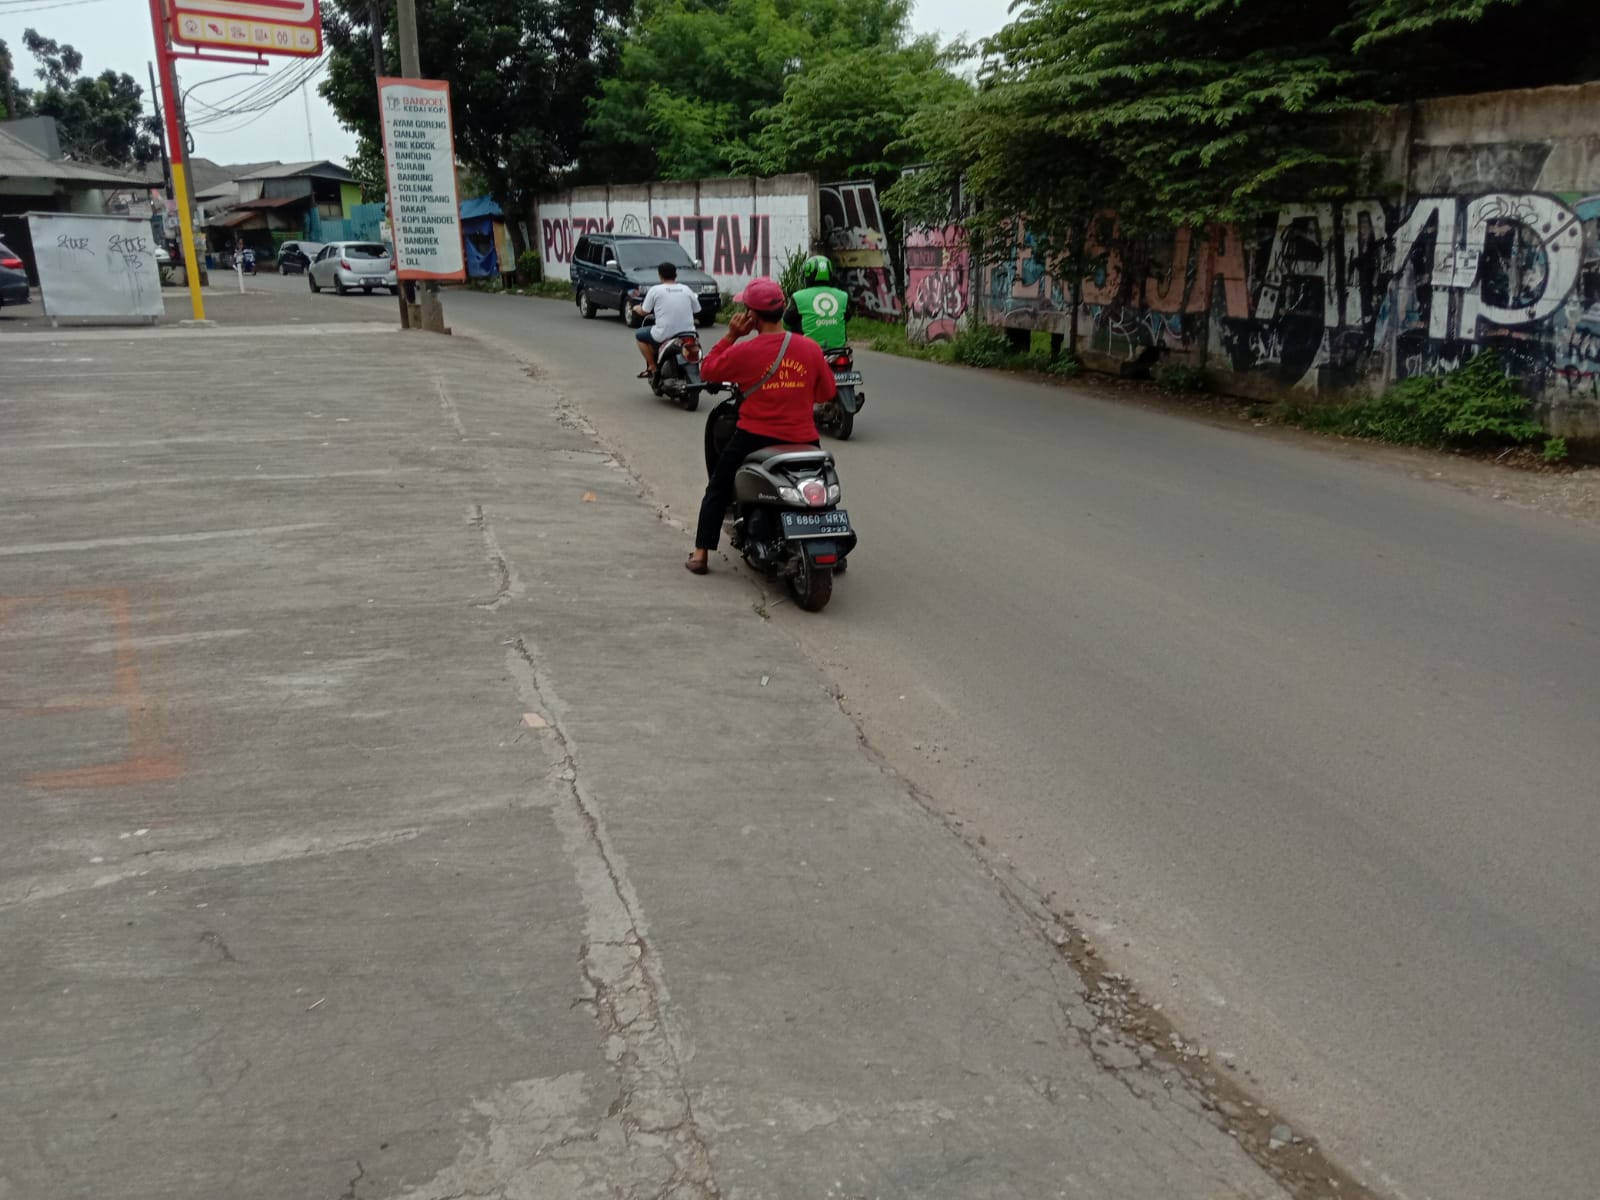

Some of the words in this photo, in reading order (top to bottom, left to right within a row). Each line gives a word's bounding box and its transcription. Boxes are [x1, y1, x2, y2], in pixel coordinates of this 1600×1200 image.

[402, 96, 443, 106] BANDOEL
[403, 105, 427, 113] KEDAI
[428, 106, 447, 114] KOPI
[393, 119, 414, 128] AYAM
[415, 120, 447, 129] GORENG
[393, 130, 426, 139] CIANJUR
[394, 141, 409, 150] MIE
[410, 141, 436, 150] KOCOK
[395, 152, 432, 161] BANDUNG
[397, 162, 425, 171] SURABI
[397, 173, 434, 182] BANDUNG
[398, 184, 433, 193] COLENAK
[400, 194, 418, 203] ROTI
[401, 205, 427, 214] BAKAR
[402, 215, 420, 224] KOPI
[421, 216, 455, 225] BANDOEL
[403, 226, 435, 235] BAJIGUR
[404, 237, 440, 246] BANDREK
[786, 515, 794, 526] B
[796, 514, 820, 526] 6860
